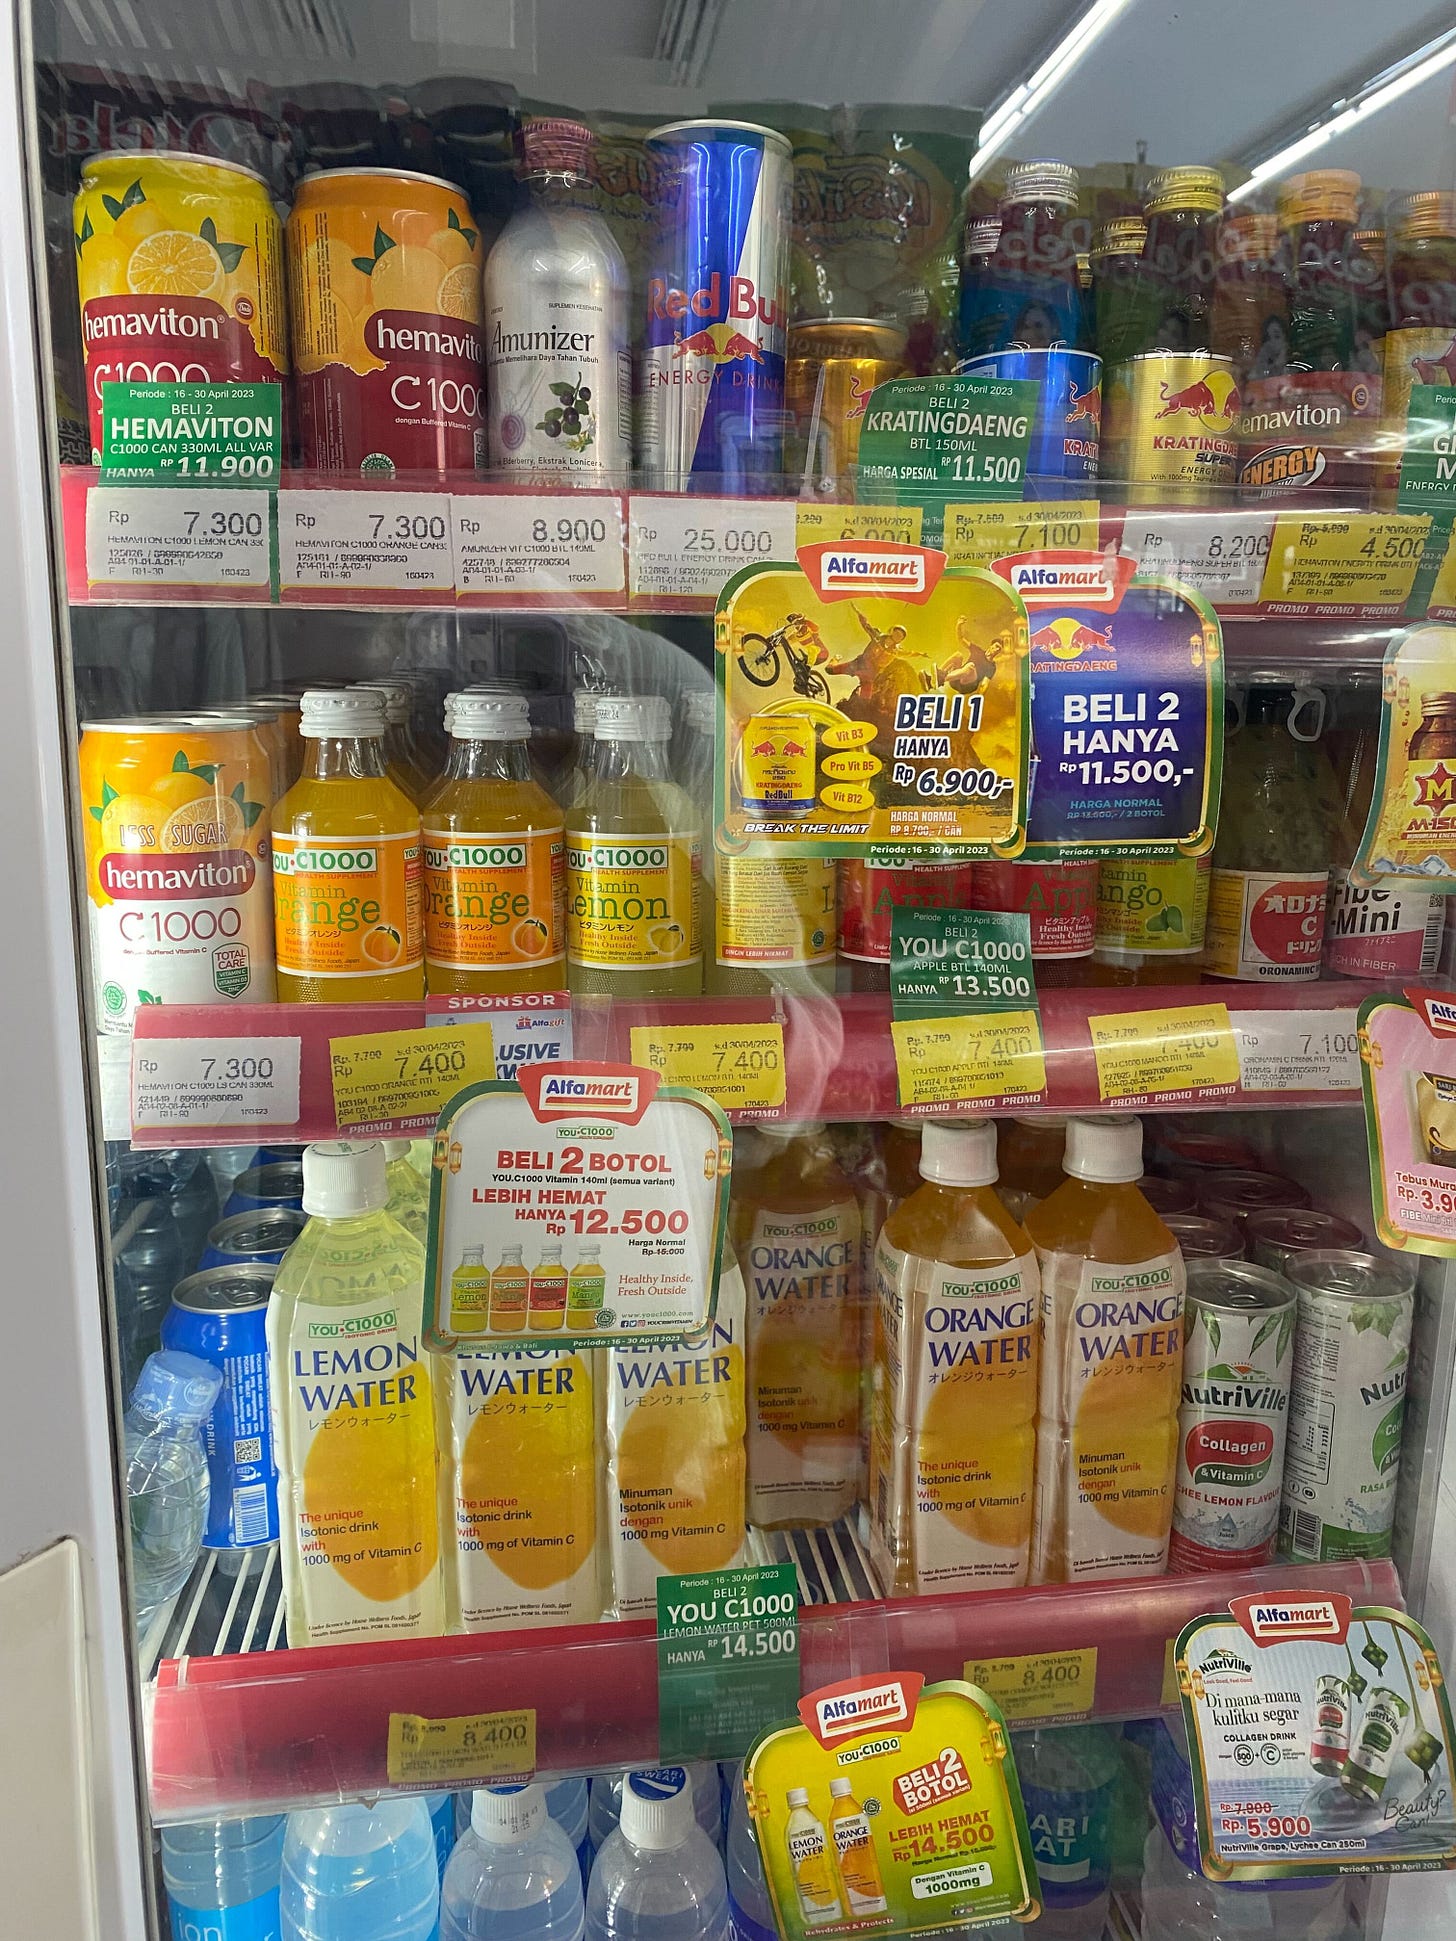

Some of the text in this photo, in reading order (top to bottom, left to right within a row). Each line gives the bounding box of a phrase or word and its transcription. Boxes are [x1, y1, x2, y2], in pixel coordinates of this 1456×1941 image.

[648, 272, 720, 321] Red
[84, 308, 219, 341] hemaviton
[491, 322, 595, 353] Amunizer
[650, 370, 780, 393] ENERGY DRINK
[129, 389, 254, 399] Periode 16 30 April 2023
[929, 398, 969, 409] BELI 2
[172, 404, 213, 415] BELI 2
[111, 417, 273, 440] HEMAVITON
[868, 410, 1028, 438] KRATINGDAENG
[111, 441, 273, 454] C1000 CAN 330ML ALL VAR
[910, 438, 977, 451] BTL 150ML
[106, 456, 273, 478] HANYA RP 11.900
[864, 455, 1021, 482] HARGA SPESIAL RP 11.500
[1195, 453, 1231, 465] SUPER
[109, 511, 262, 537] Rp 7.300
[296, 514, 445, 540] Rp 7.300
[461, 519, 606, 542] Rp 8.900
[639, 527, 772, 552] Rp 25.000
[956, 523, 1080, 548] Rp 7.100
[1145, 534, 1269, 557] Rp 8.200
[1300, 535, 1425, 559] Rp 4.500
[828, 557, 918, 576] Alfamart
[1268, 604, 1399, 614] PROMO PROMO PROMO
[895, 696, 982, 729] BELI 1
[1064, 693, 1179, 724] BELI 2
[836, 729, 863, 741] Vit B3
[1064, 728, 1179, 754] HANYA
[896, 739, 950, 757] HANYA
[830, 761, 874, 771] Pro Vit B5
[1060, 760, 1193, 786] Rp 11.500,-
[895, 765, 1012, 797] Rp 6.900,-
[1070, 798, 1163, 809] HARGA NORMAL
[120, 823, 228, 846] LESS SUGAR
[744, 823, 869, 834] BREAK THE LIMIT
[107, 860, 247, 890] hemaviton
[576, 876, 640, 894] Vitamin
[217, 950, 246, 961] TOTAL
[899, 937, 1025, 962] YOU C1000
[218, 958, 245, 969] CARE
[913, 962, 1011, 974] APPLE BTL 140ML
[1363, 960, 1396, 970] FIBER
[898, 975, 1030, 997] HANYA RP 13.500
[448, 995, 556, 1009] SPONSOR
[1242, 1033, 1357, 1055] Rp 7.100
[139, 1058, 273, 1081] Rp 7.300
[395, 1051, 466, 1080] 7.400
[546, 1079, 632, 1096] Alfamart
[497, 1147, 672, 1174] BELI 2 BOTOL
[545, 1175, 675, 1187] Vitamin 140ml (semua variant)
[472, 1189, 607, 1204] LEBIH HEMAT
[515, 1209, 566, 1221] HANYA
[546, 1210, 689, 1236] Rp 12.500
[618, 1285, 687, 1297] Fresh Outside
[619, 1274, 693, 1286] Healthy Inside,
[924, 1297, 1034, 1333] ORANGE
[294, 1336, 418, 1377] LEMON
[928, 1337, 1032, 1367] WATER
[461, 1366, 574, 1397] WATER
[299, 1374, 417, 1412] WATER
[1200, 1435, 1266, 1453] Collagen
[1210, 1468, 1254, 1481] Vitamin
[619, 1486, 673, 1499] Minuman
[620, 1499, 666, 1513] Isotonik
[300, 1520, 379, 1537] Isotonic drink
[667, 1593, 794, 1624] YOU C1000
[1257, 1607, 1330, 1622] Alfamart
[667, 1630, 795, 1664] HANYA RP 14.500
[1023, 1666, 1080, 1686] 8.400
[823, 1690, 898, 1720] Alfamart
[1207, 1691, 1302, 1708] Di mana-mana
[1213, 1709, 1299, 1726] kulitku segar
[1224, 1732, 1297, 1743] COLLAGEN DRINK
[898, 1749, 962, 1792] BELI 2
[902, 1777, 968, 1807] BOTOL
[889, 1810, 990, 1842] LEBIH HEMAT
[1222, 1816, 1311, 1838] Rp. 5.900
[910, 1825, 994, 1856] 14.500
[925, 1877, 980, 1895] 1000mg
